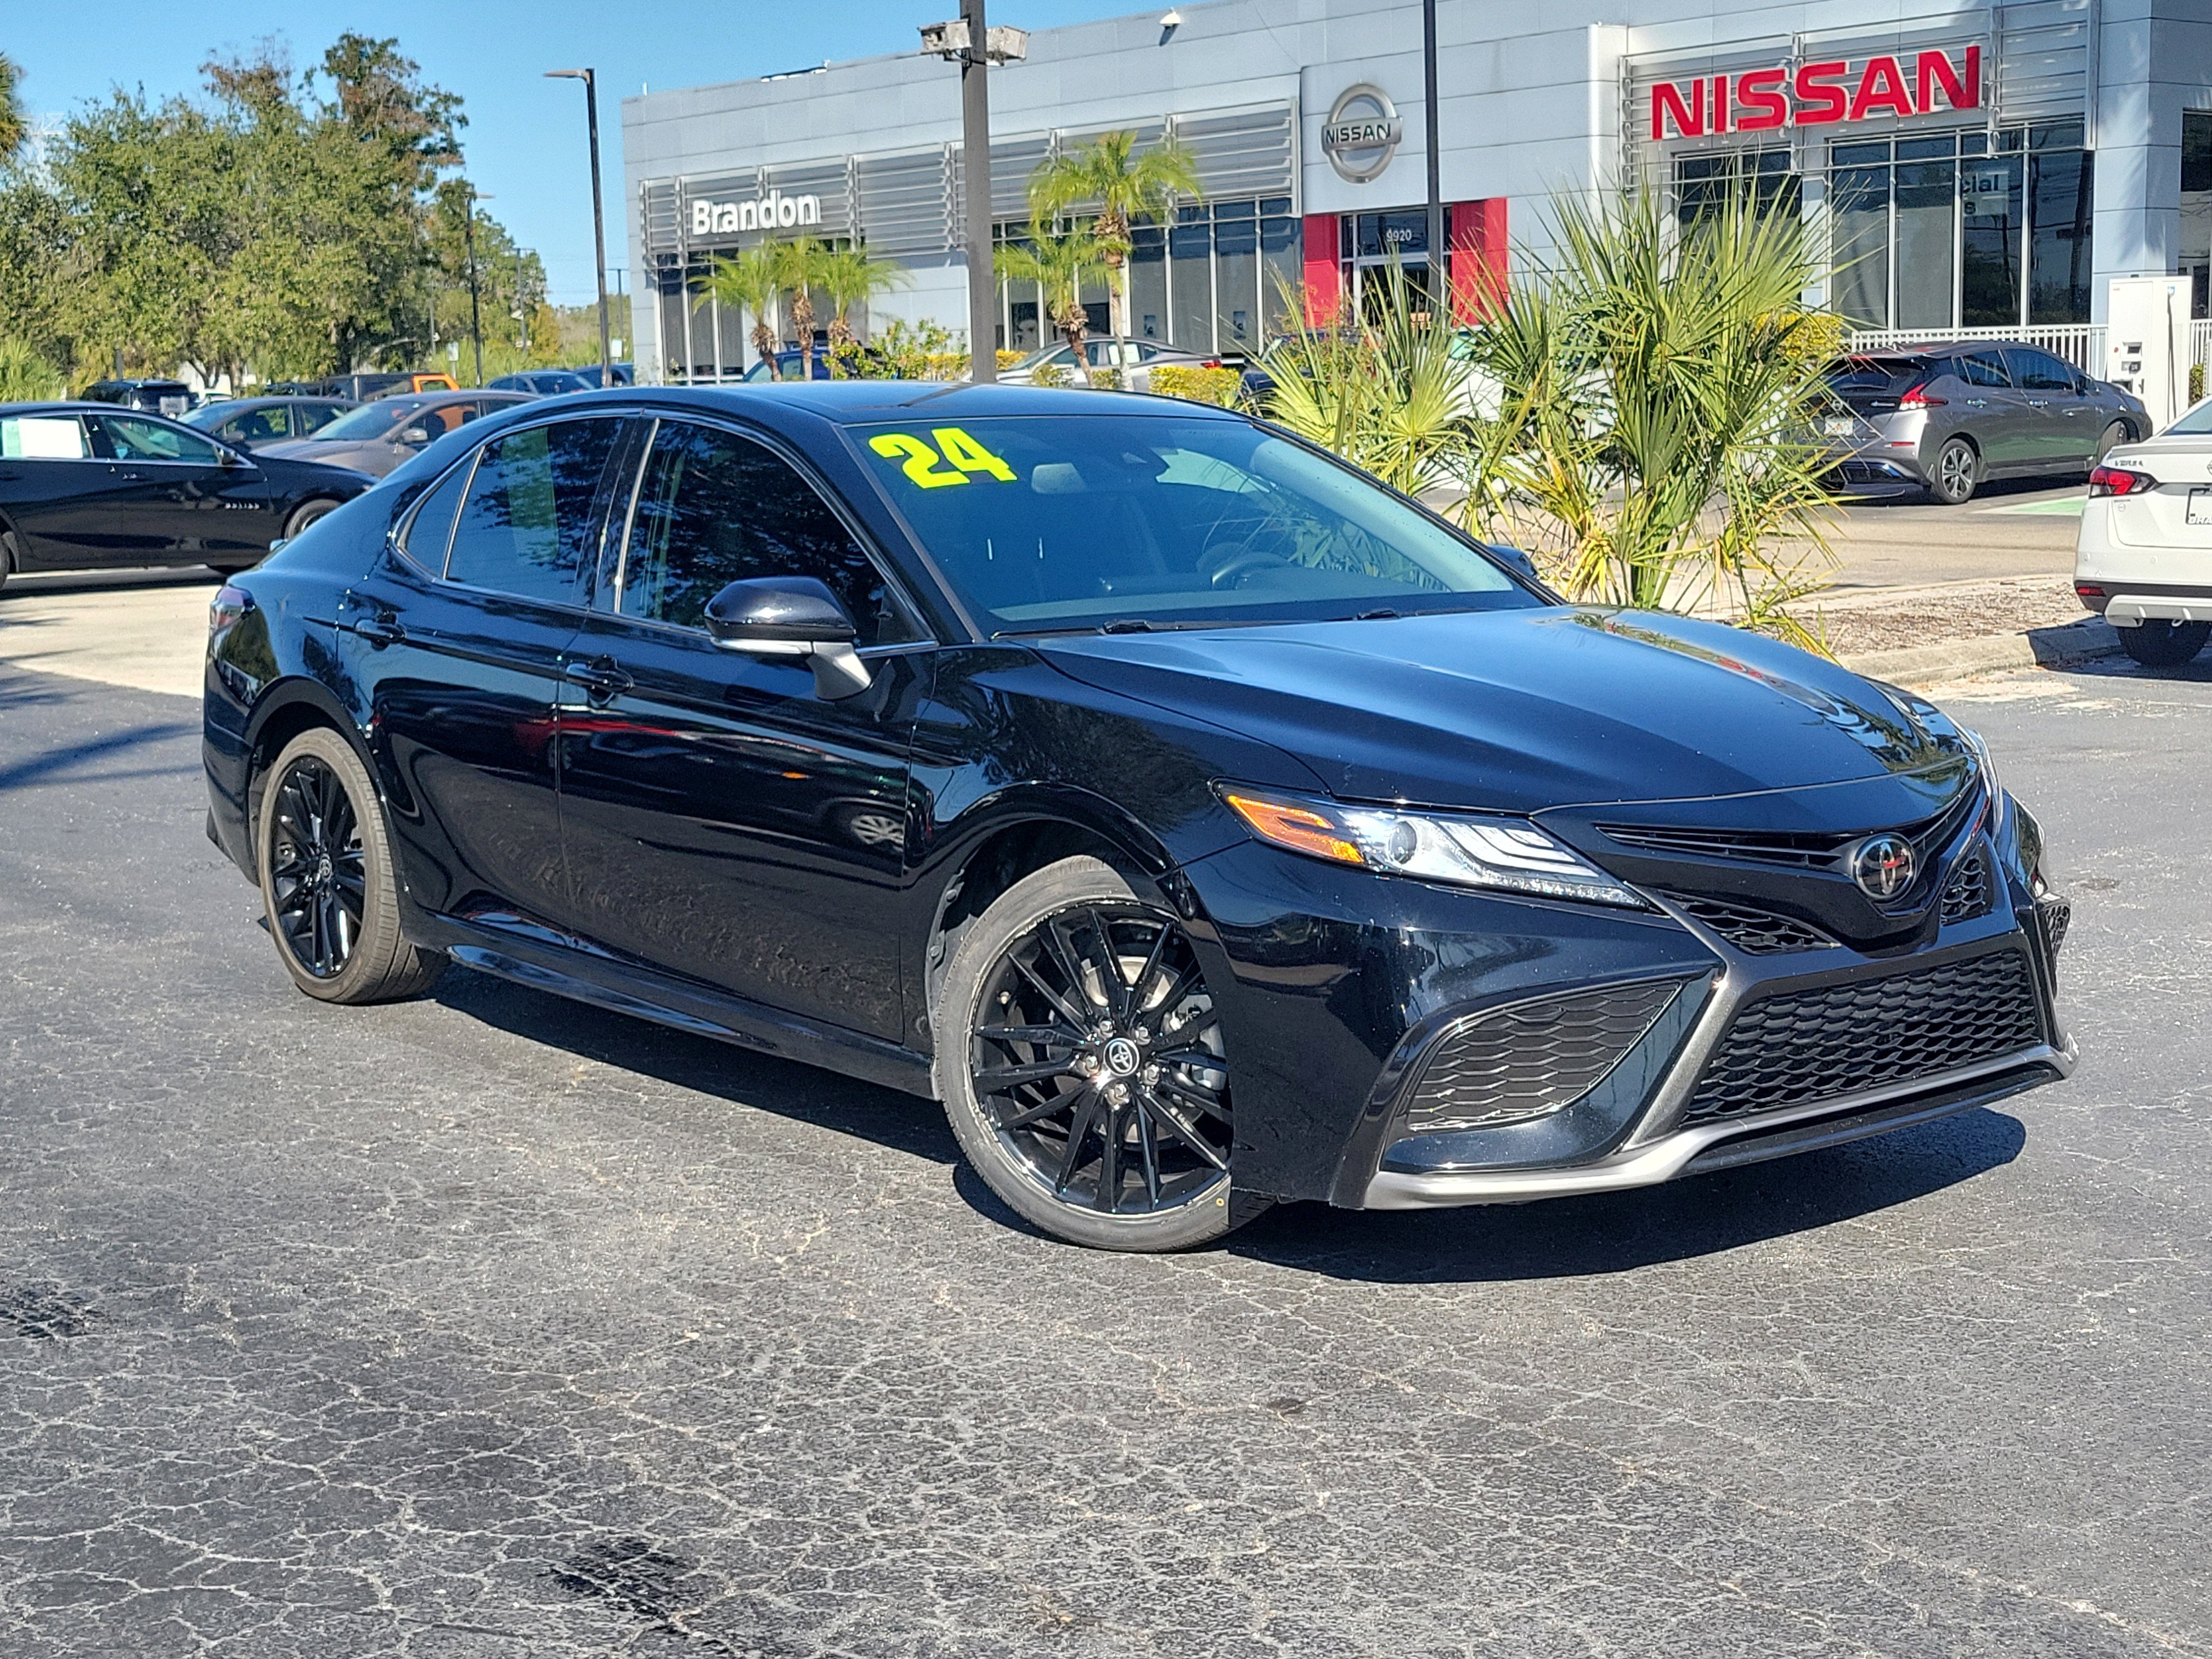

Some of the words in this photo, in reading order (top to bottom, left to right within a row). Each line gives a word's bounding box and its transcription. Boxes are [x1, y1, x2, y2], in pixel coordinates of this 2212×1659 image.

[1651, 45, 1982, 140] NISSAN
[1325, 123, 1391, 144] NISSAN
[692, 189, 821, 235] Brandon
[1386, 228, 1412, 242] 9920
[868, 428, 1018, 489] 24
